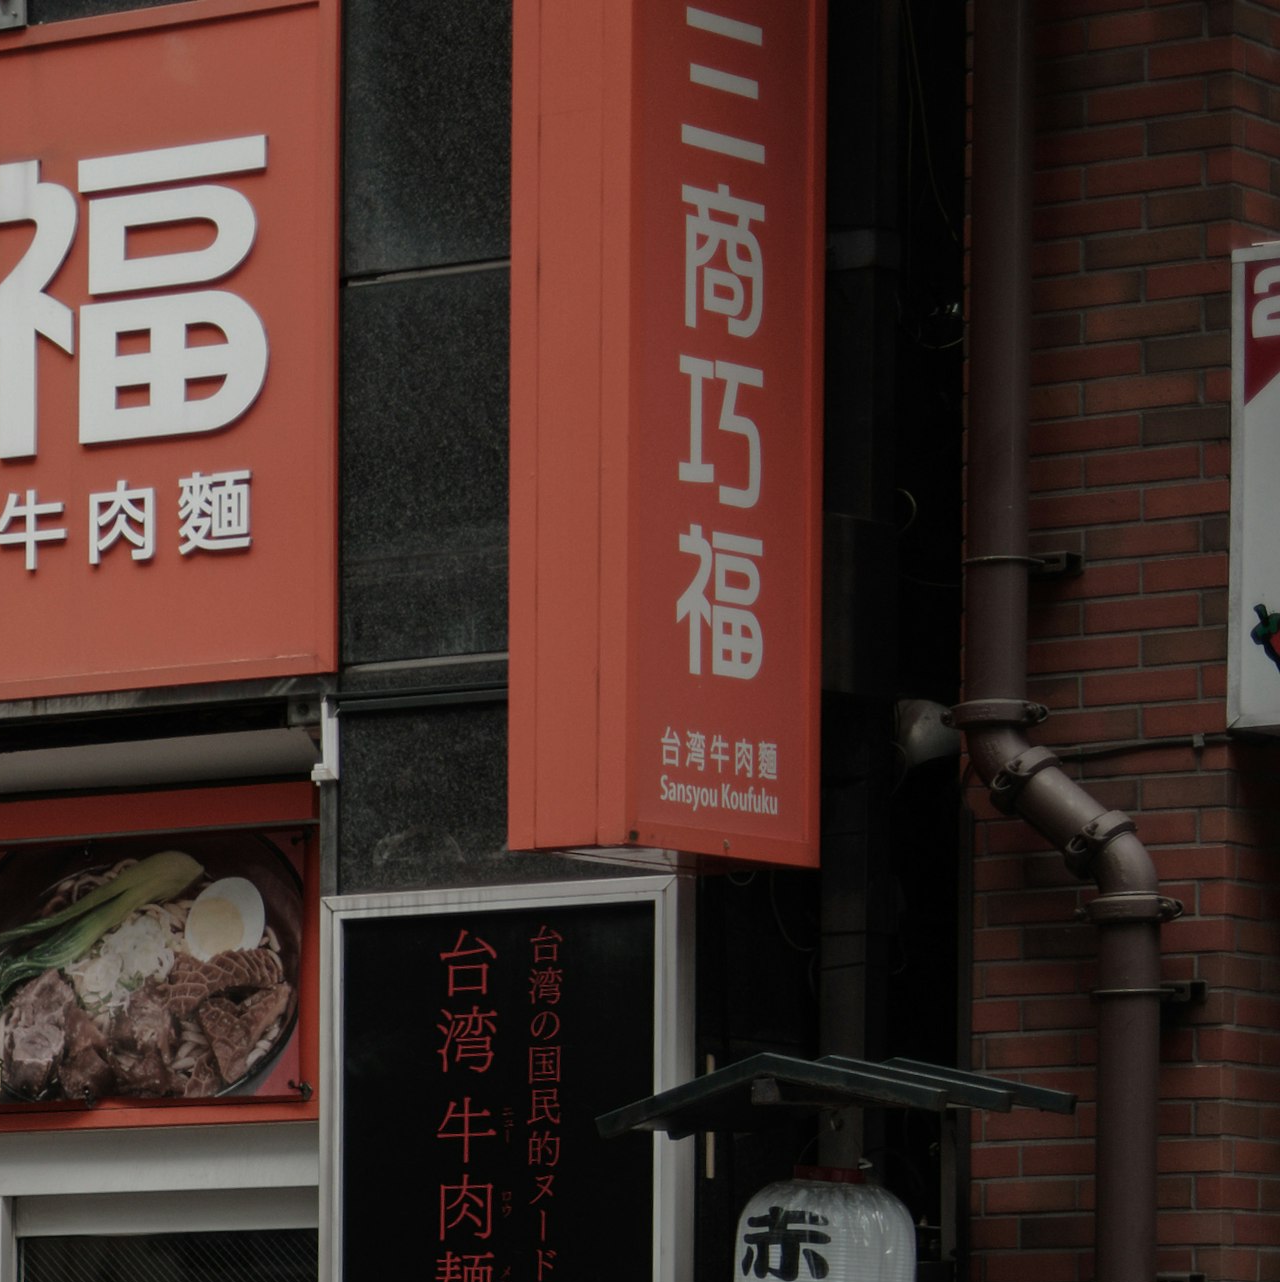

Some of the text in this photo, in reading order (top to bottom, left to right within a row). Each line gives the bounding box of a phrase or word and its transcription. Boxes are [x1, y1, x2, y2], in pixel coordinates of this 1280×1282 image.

[676, 6, 766, 682] 三商巧福
[659, 774, 778, 816] Sansyou Koufuku
